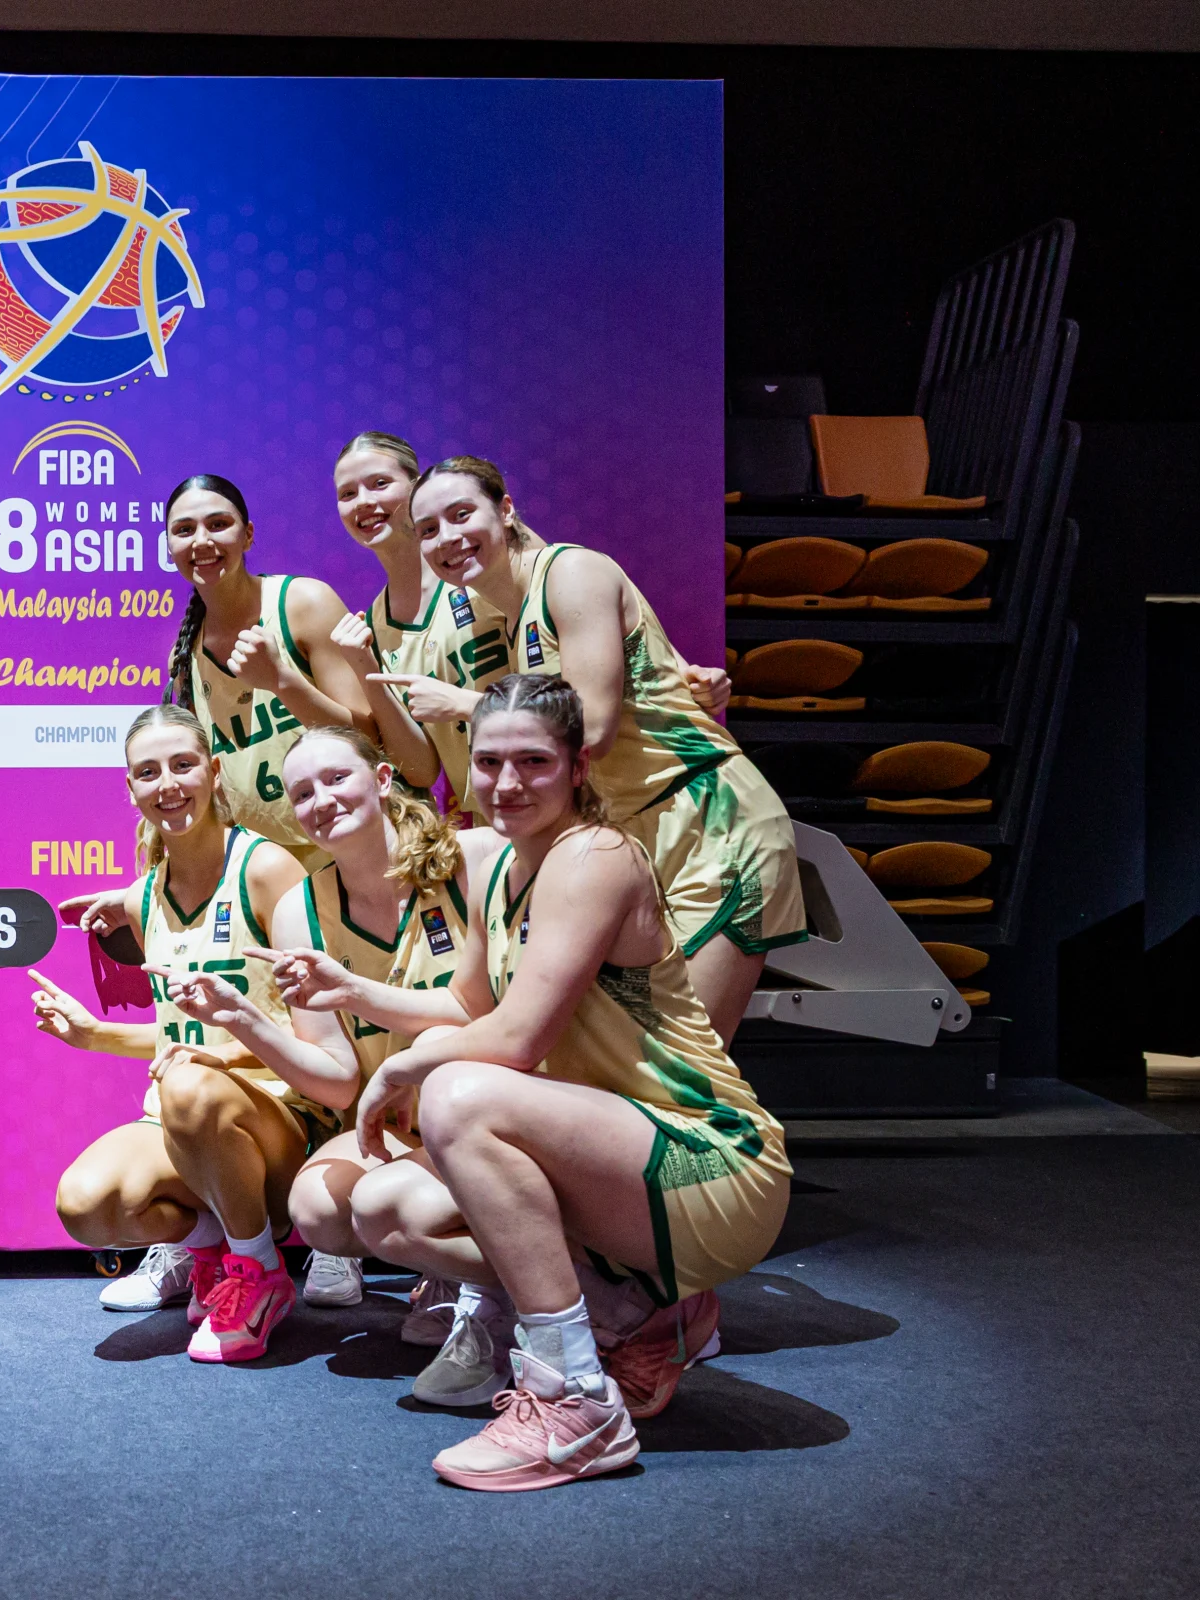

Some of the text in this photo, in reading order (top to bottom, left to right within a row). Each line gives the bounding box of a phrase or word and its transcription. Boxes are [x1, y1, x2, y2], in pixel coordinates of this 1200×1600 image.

[39, 449, 115, 485] FIBA
[45, 501, 164, 523] WOMEN
[45, 529, 143, 572] ASIA
[119, 589, 174, 618] 2026
[35, 726, 117, 743] CHAMPION
[256, 760, 285, 802] 6
[31, 841, 123, 876] FINAL
[431, 932, 448, 944] FIBA
